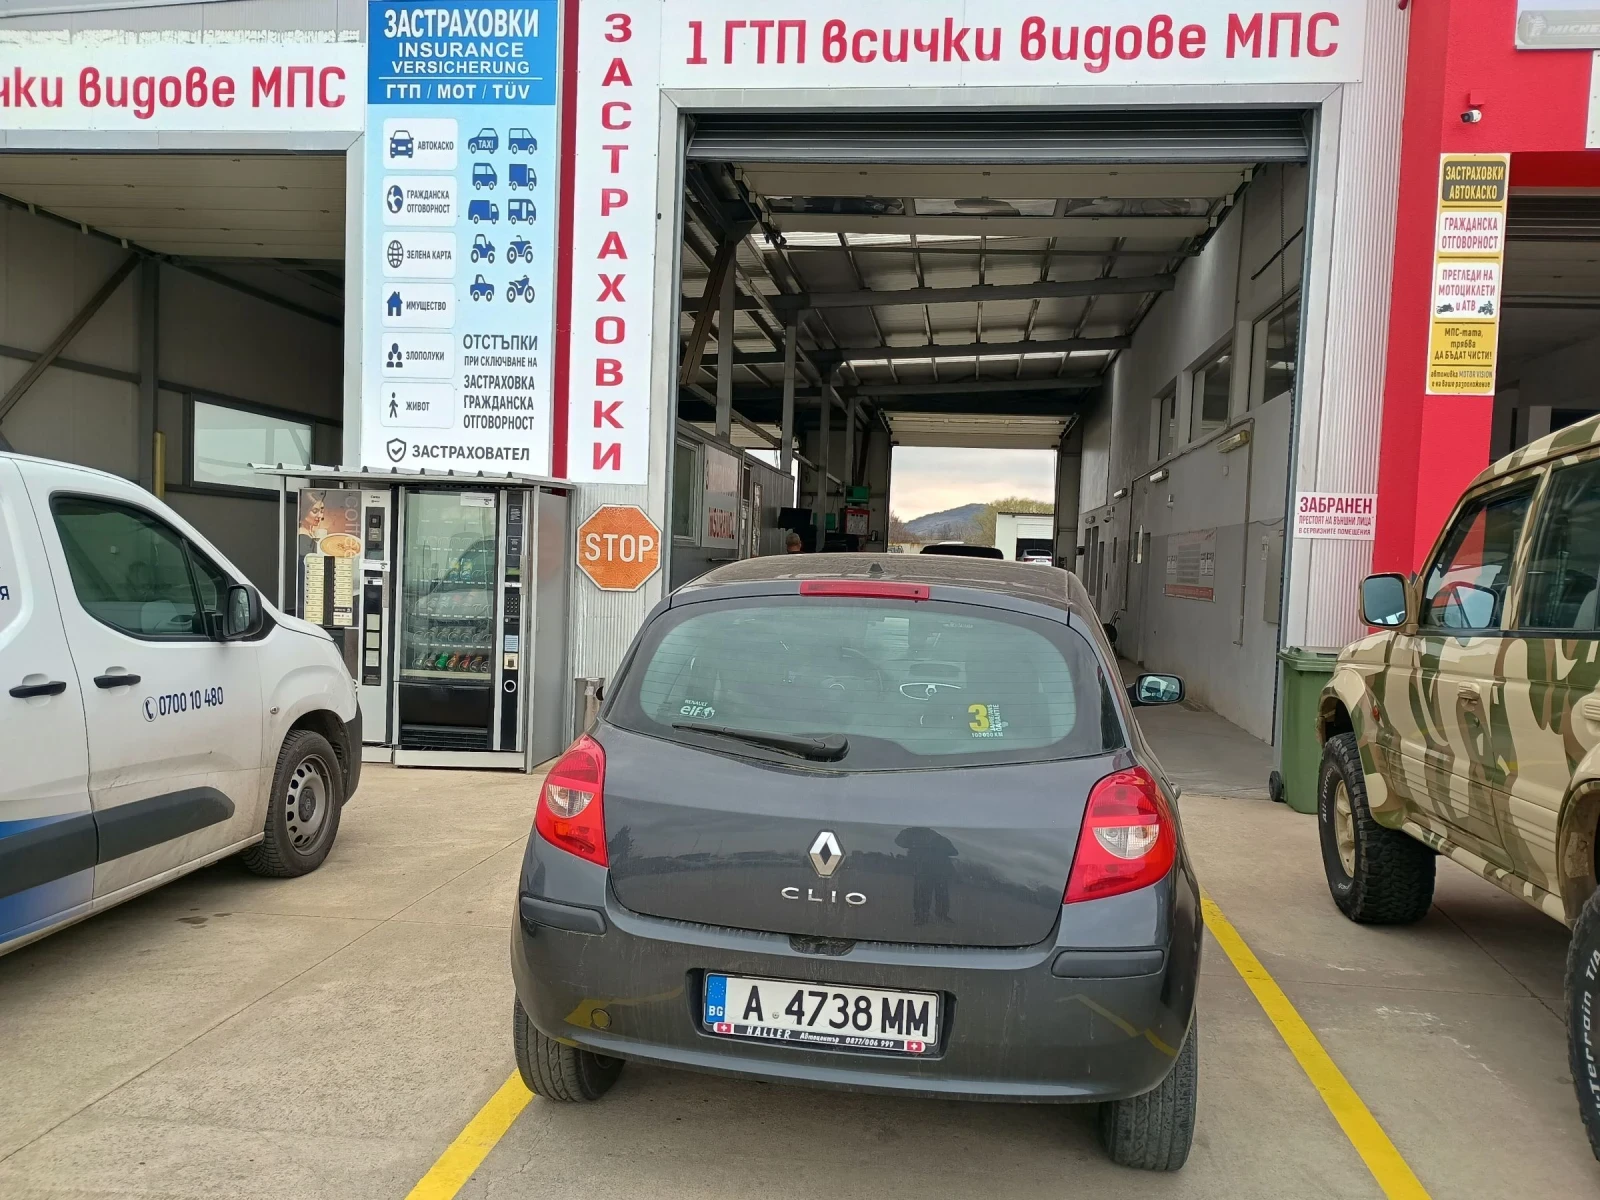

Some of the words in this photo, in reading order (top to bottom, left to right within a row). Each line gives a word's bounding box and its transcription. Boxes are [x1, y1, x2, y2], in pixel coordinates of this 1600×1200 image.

[384, 8, 539, 38] ЗАСТРАХОВКИ
[398, 42, 524, 58] INSURANCE
[686, 21, 708, 64] 1
[723, 19, 806, 64] ГТП
[822, 17, 1001, 63] всички
[1019, 14, 1207, 74] видове
[1225, 11, 1340, 59] МПС
[391, 60, 530, 74] VERSICHERUNG
[78, 66, 235, 120] видове
[252, 66, 346, 108] МПС
[386, 84, 421, 99] ГТП
[492, 81, 530, 100] TÜV
[417, 141, 454, 151] АВТОКАСКО
[478, 139, 494, 149] TAXI
[1445, 166, 1504, 181] ЗАСТРАХОВКИ
[406, 189, 450, 201] ГРАЖДАНСКА
[1448, 185, 1498, 200] АВТОКАСКО
[406, 203, 450, 214] ОТГОВОРНОСТ
[1444, 217, 1498, 232] ГРАЖДАНСКА
[592, 13, 633, 471] ЗАСТРАХОВКИ
[1441, 235, 1498, 250] ОТГОВОРНОСТ
[406, 250, 431, 260] ЗЕЛЕНА
[431, 250, 452, 260] КАРТА
[1442, 269, 1482, 282] ПРЕГЛЕДИ
[1483, 269, 1494, 281] НА
[1438, 285, 1496, 298] МОТОЦИКЛЕТИ
[406, 301, 447, 311] ИМУЩЕСТВО
[463, 334, 538, 351] ОТСТЪПКИ
[406, 351, 445, 361] ЗЛОПОЛУКИ
[464, 356, 479, 366] ПРИ
[480, 356, 526, 367] СКЛЮЧВАНЕ
[527, 357, 538, 367] НА
[1434, 350, 1444, 360] ДА
[1445, 351, 1467, 360] БЪДАТ
[1467, 351, 1492, 360] ЧИСТИ!
[464, 374, 535, 390] ЗАСТРАХОВКА
[405, 401, 430, 411] ЖИВОТ
[463, 395, 534, 411] ГРАЖДАНСКА
[463, 414, 534, 430] ОТГОВОРНОСТ
[412, 444, 530, 461] ЗАСТРАХОВАТЕЛ
[1300, 496, 1372, 514] ЗАБРАНЕН
[584, 533, 654, 563] STOP
[159, 692, 187, 716] 0700
[189, 690, 202, 710] 10
[204, 686, 224, 707] 480
[680, 705, 704, 716] elf
[968, 704, 990, 732] 3
[781, 886, 867, 905] CLIO
[708, 1005, 723, 1017] BG
[742, 985, 764, 1022] A
[784, 989, 873, 1031] 4738
[880, 997, 930, 1037] MM
[746, 1025, 791, 1040] HALLER
